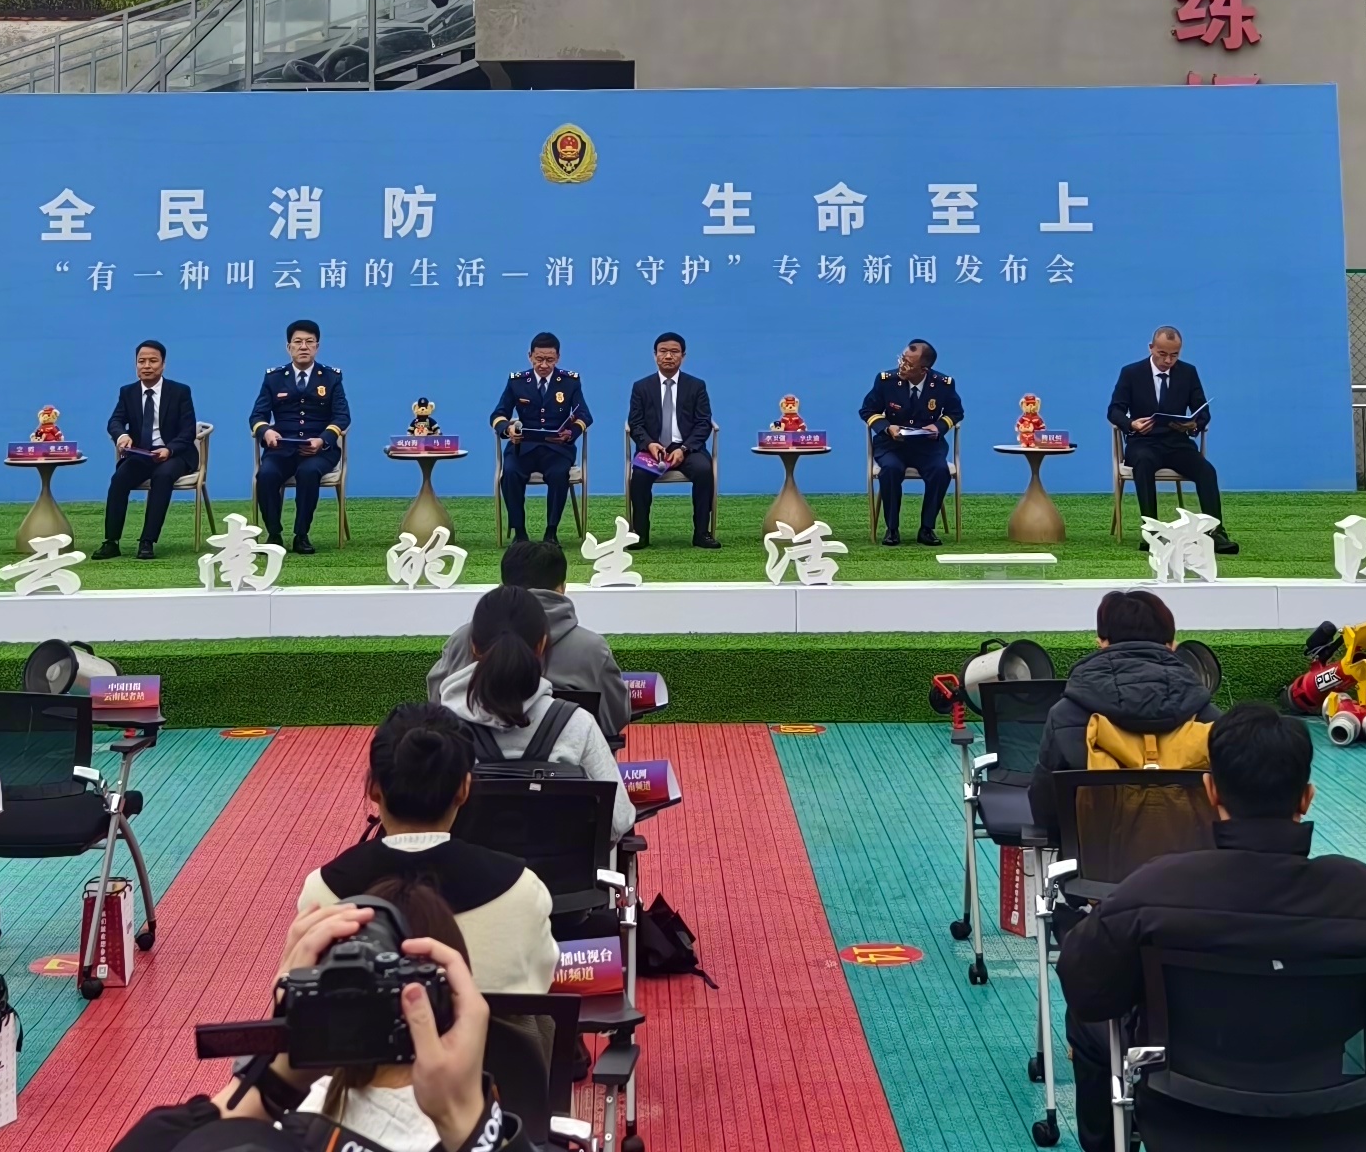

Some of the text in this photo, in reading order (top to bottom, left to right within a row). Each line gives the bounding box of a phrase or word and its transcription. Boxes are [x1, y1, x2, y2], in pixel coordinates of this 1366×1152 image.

[38, 181, 1094, 242] 全民消防 生命至上
[104, 691, 145, 701] 云南记者站
[108, 682, 141, 692] 中国日报
[623, 768, 647, 786] 人民网
[624, 780, 652, 793] 南频道
[560, 947, 614, 967] 播电视台
[852, 945, 911, 963] 14
[552, 965, 595, 984] 市频道
